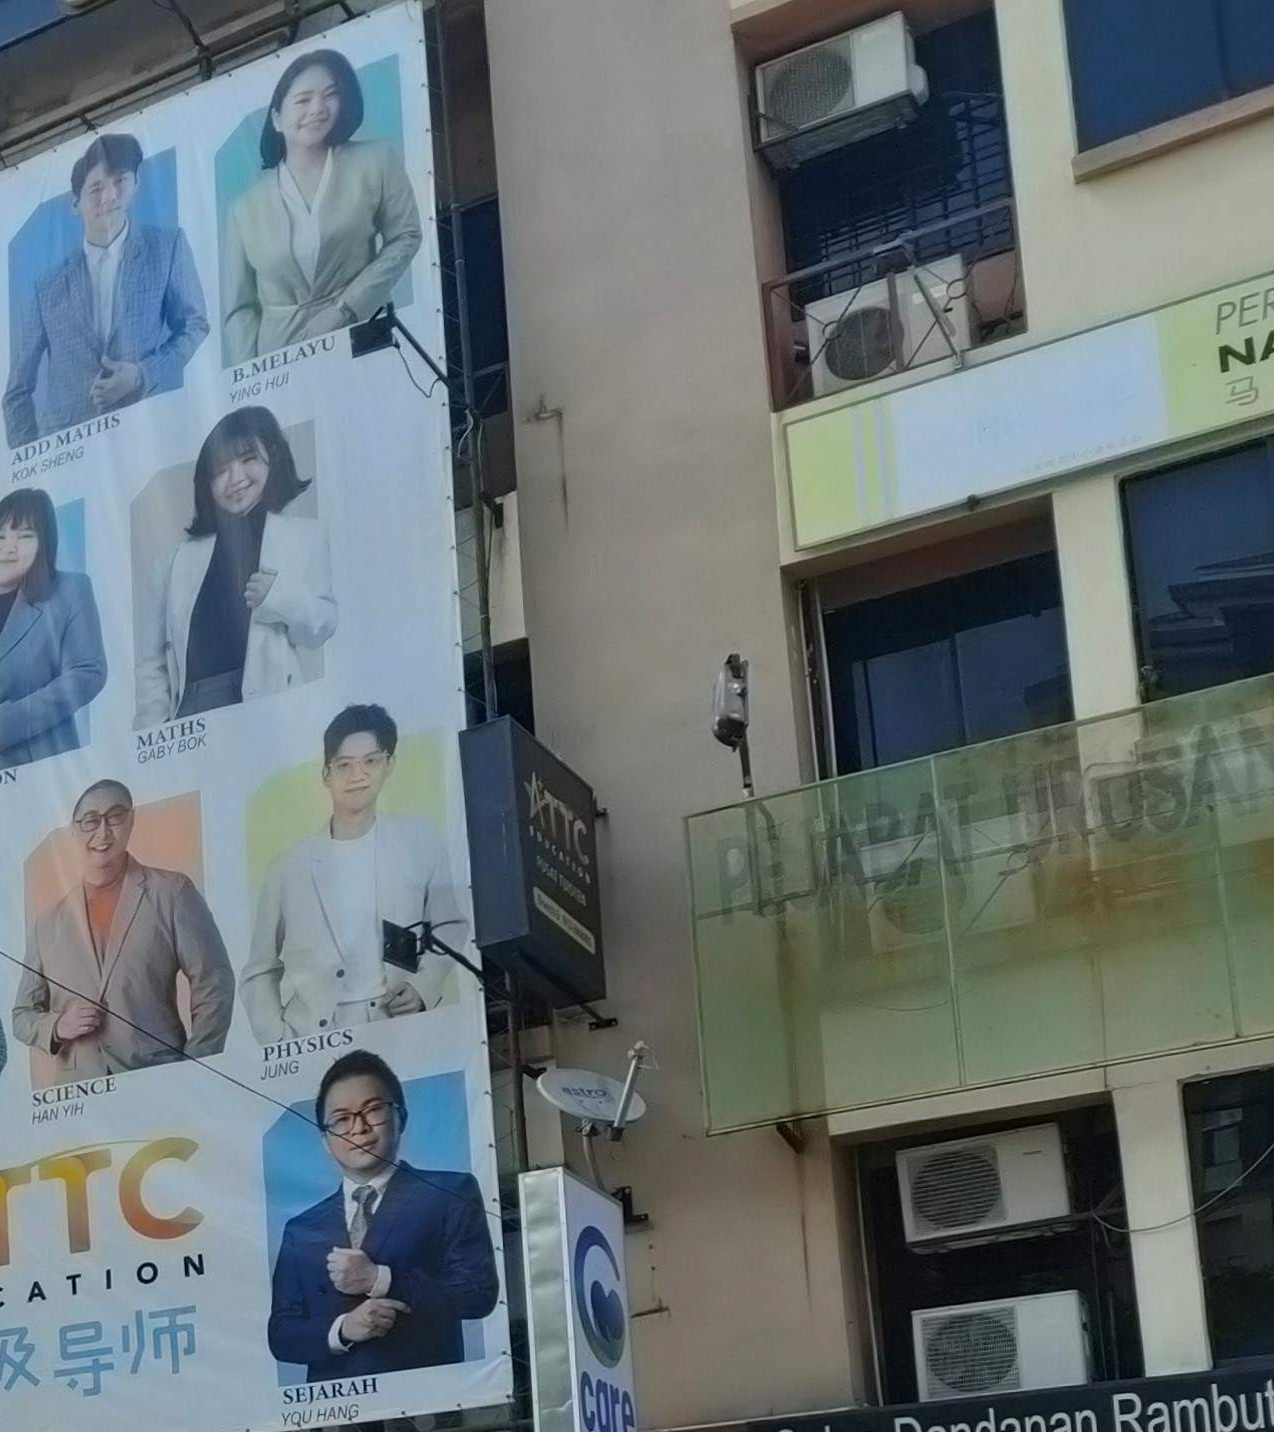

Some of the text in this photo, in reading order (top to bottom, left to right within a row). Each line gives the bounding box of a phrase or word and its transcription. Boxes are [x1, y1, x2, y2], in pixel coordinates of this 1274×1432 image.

[231, 336, 336, 385] B.MELAYU
[229, 371, 290, 404] YING HUI
[11, 413, 121, 466] ADD MATHS
[11, 446, 85, 485] KOK SHENG
[136, 718, 207, 750] MATHS
[136, 734, 207, 765] GABY BOK
[262, 1028, 354, 1062] PHYSICS
[260, 1062, 300, 1082] JUNG
[31, 1076, 117, 1108] SCIENCE
[31, 1102, 85, 1125] HAN YIH
[282, 1376, 380, 1406] SEJARAH
[317, 1402, 361, 1424] HANG
